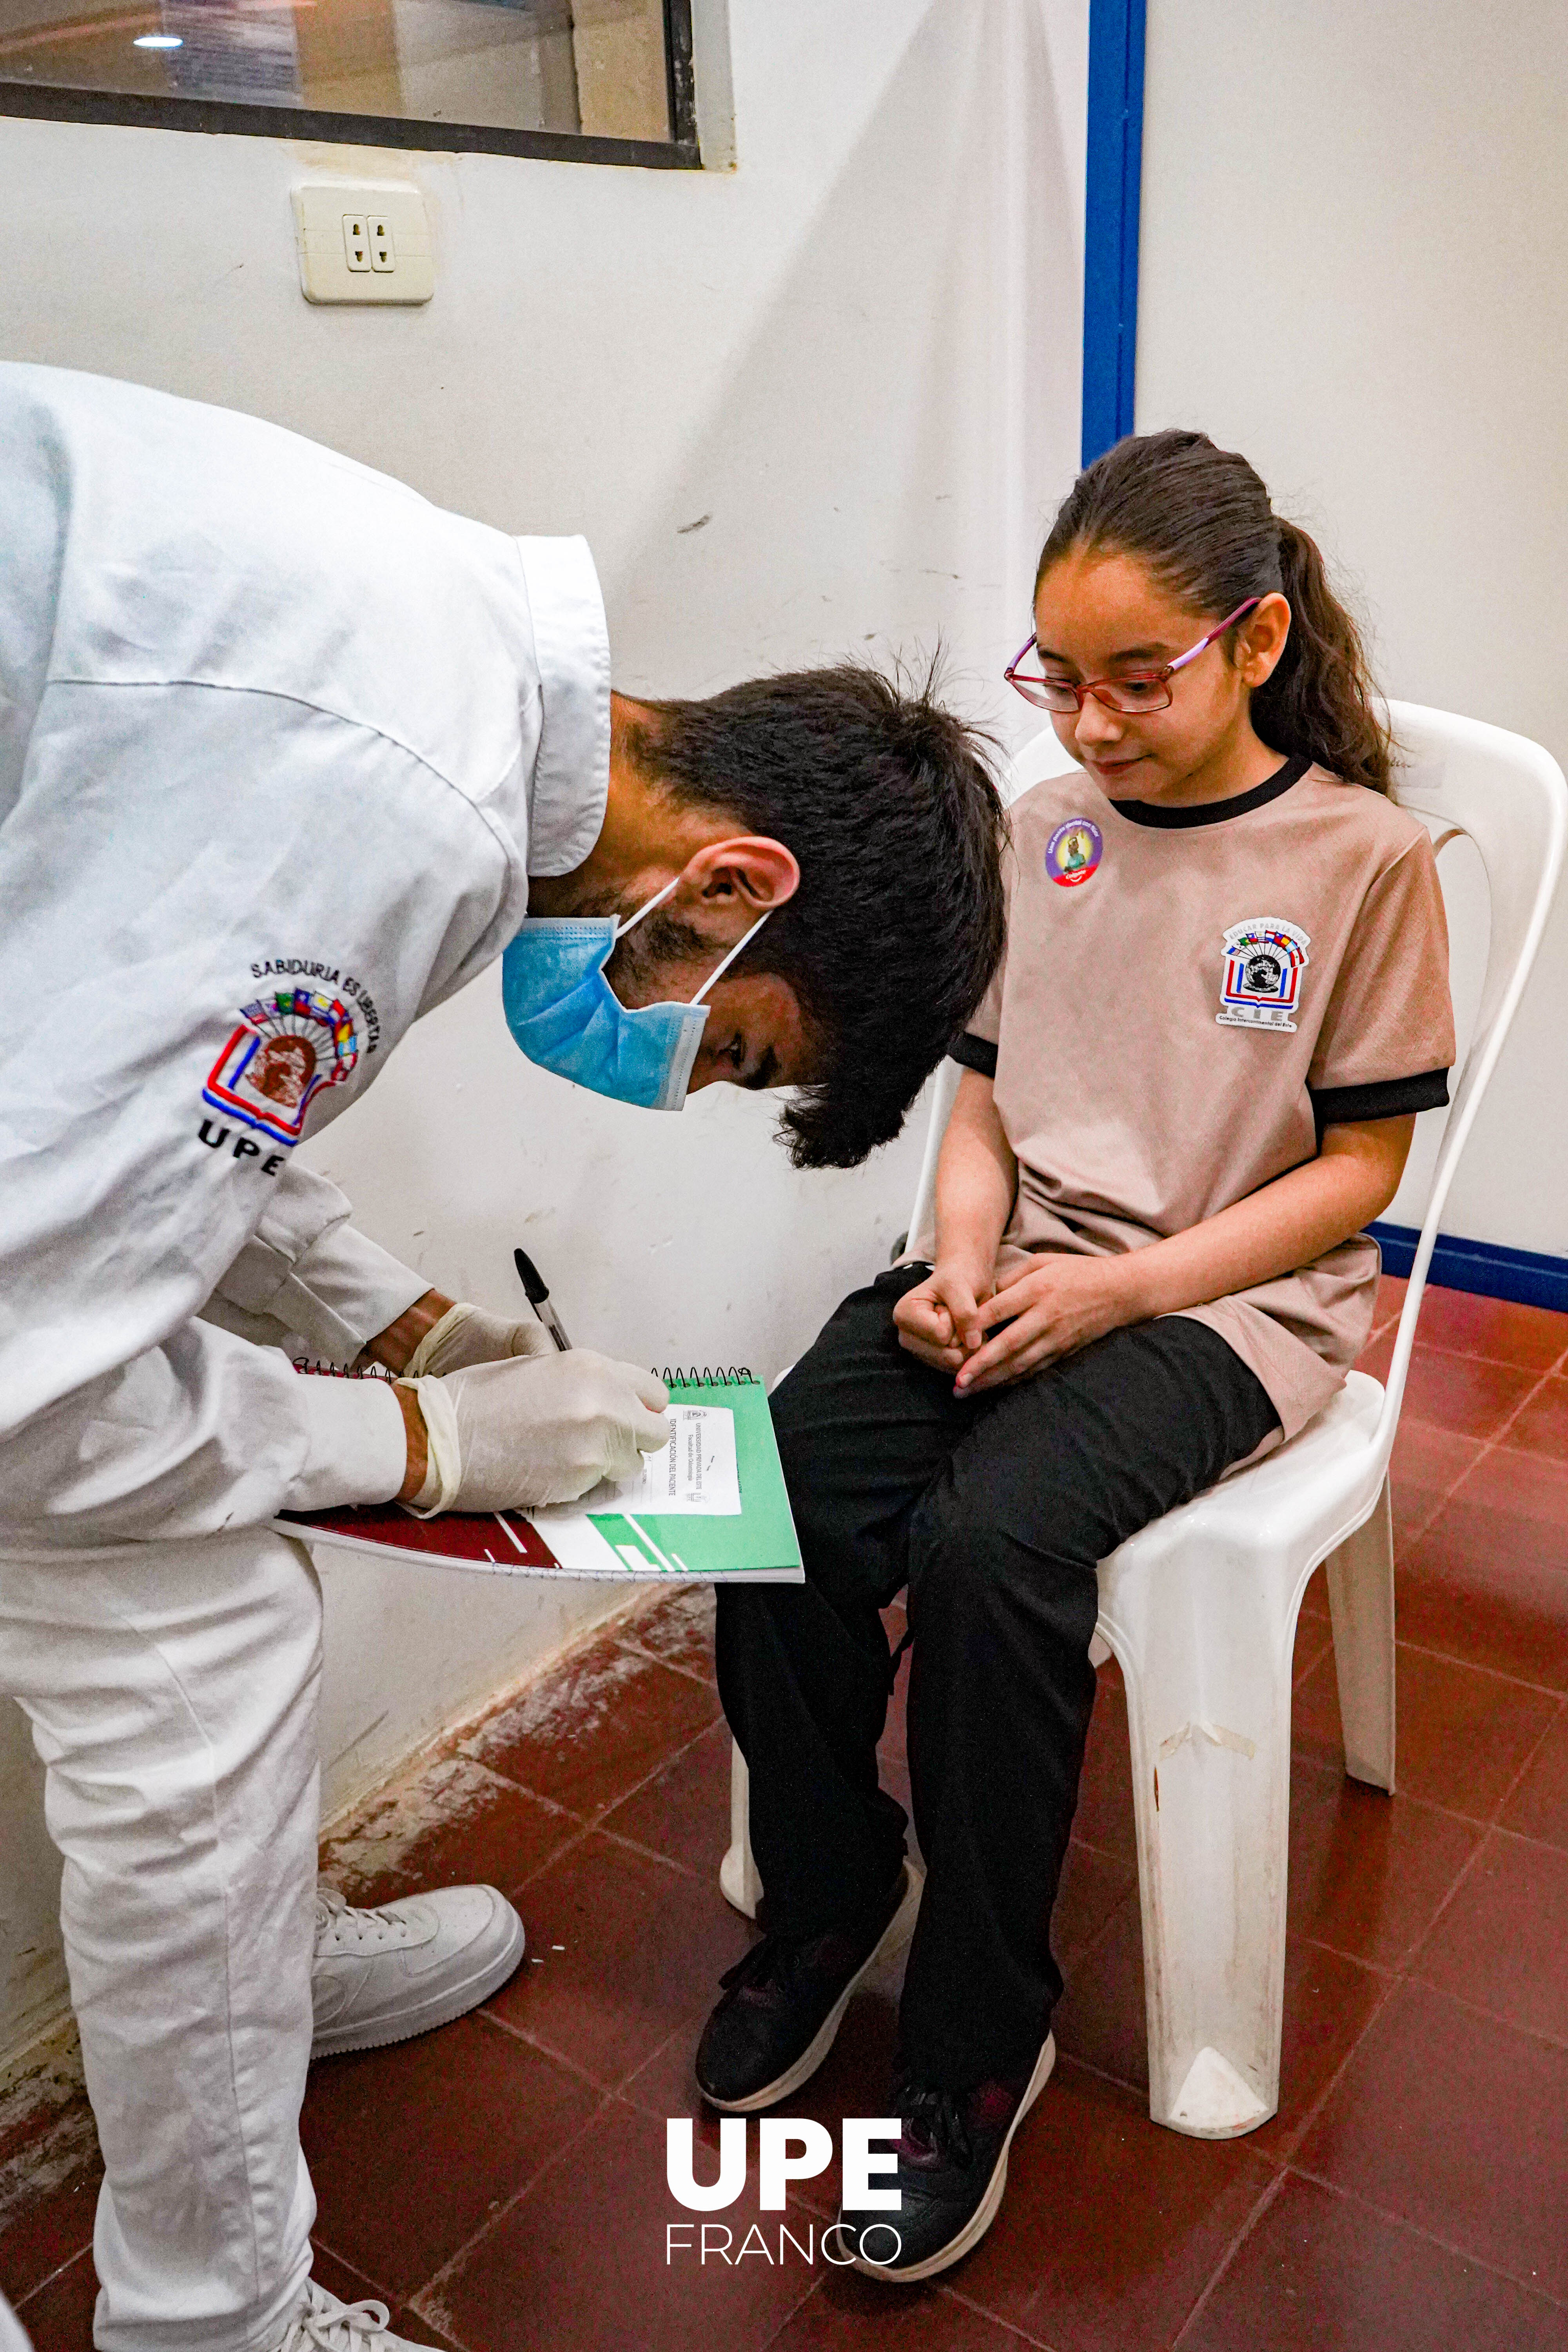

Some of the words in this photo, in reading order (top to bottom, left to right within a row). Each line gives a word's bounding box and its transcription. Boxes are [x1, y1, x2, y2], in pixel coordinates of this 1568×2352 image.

[1229, 924, 1256, 939] EDUCAR
[1292, 930, 1306, 944] VIDA
[251, 959, 339, 984] SABIDURIA
[1231, 1007, 1283, 1021] CIE
[198, 1119, 284, 1176] UPE
